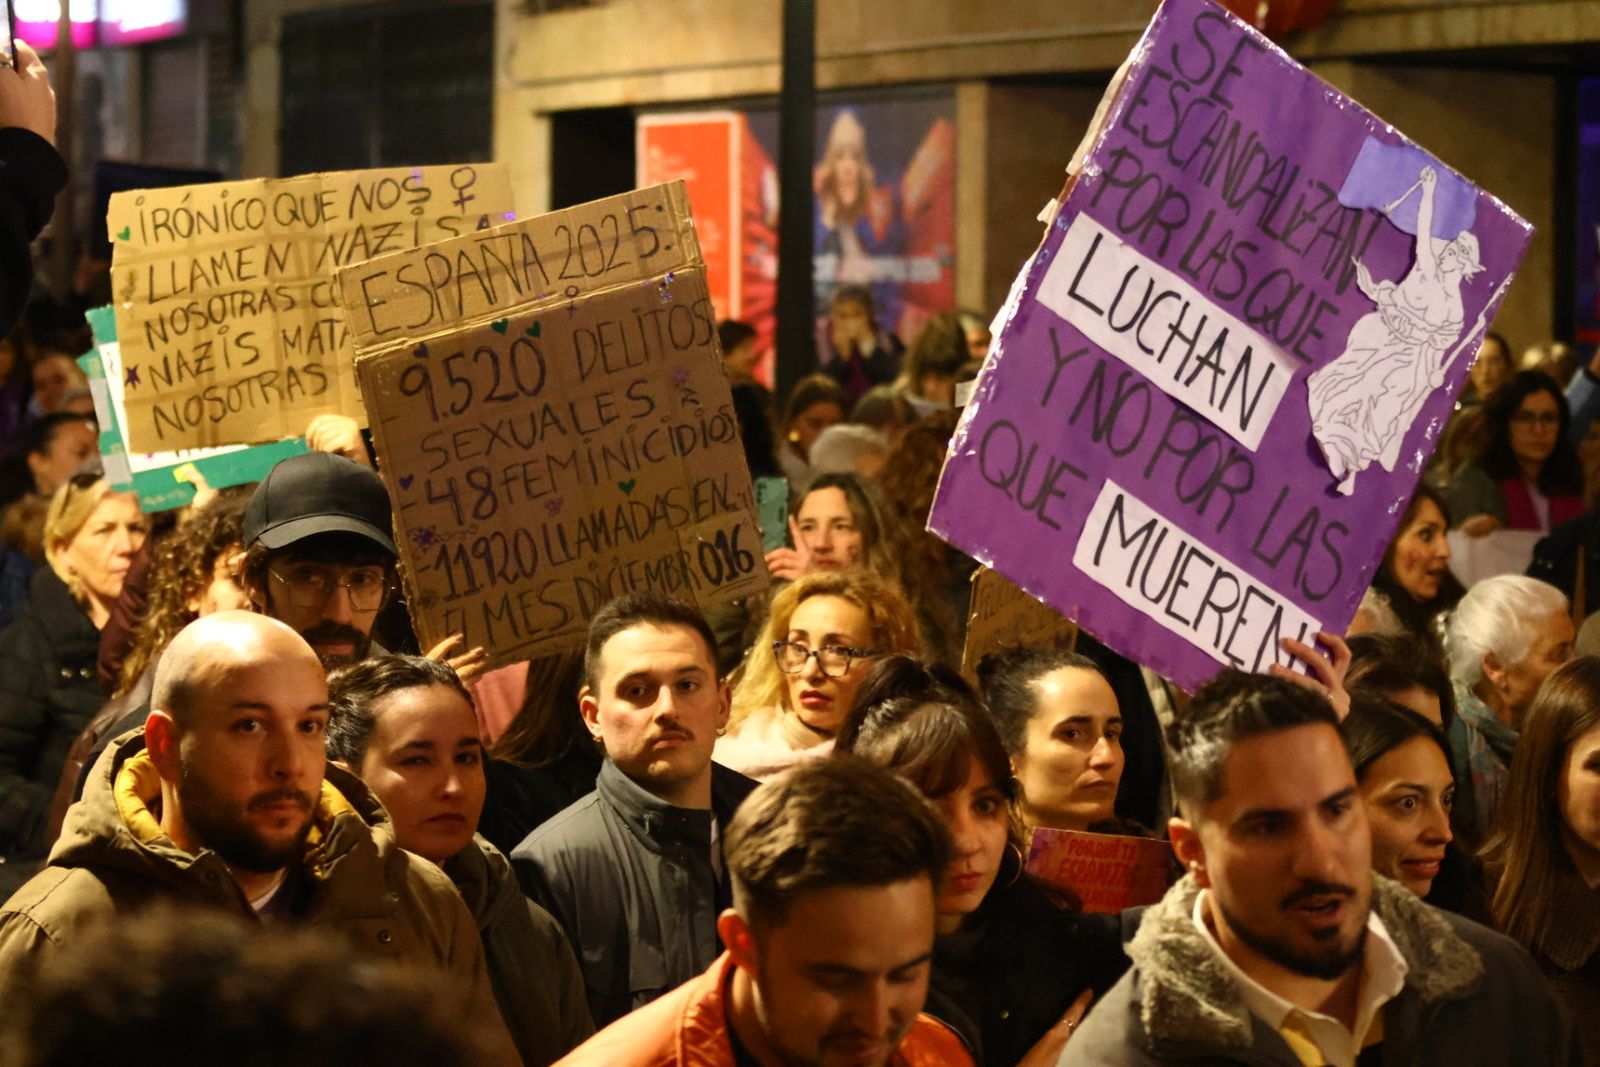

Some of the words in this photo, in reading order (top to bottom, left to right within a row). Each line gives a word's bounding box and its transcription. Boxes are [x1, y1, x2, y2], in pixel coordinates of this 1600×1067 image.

[1172, 11, 1267, 110] SE
[272, 189, 340, 229] QUE
[348, 173, 432, 220] NOS
[1120, 65, 1384, 298] ESCANDALIZAN
[147, 241, 292, 304] LLAMEN
[360, 232, 550, 336] ESPAÑA
[555, 204, 674, 282] 2025:
[1086, 148, 1191, 257] POR
[1177, 221, 1259, 301] LAS
[1246, 268, 1340, 364] QUE
[144, 285, 297, 351] NOSOTRAS
[573, 298, 714, 382] DELITOS
[1066, 231, 1278, 433] LUCHAN
[151, 362, 329, 440] NOSOTRAS
[420, 380, 657, 473] SEXUALES
[977, 420, 1088, 531] QUE
[1038, 327, 1090, 407] Y
[1068, 356, 1151, 457] NO
[1142, 406, 1256, 531] POR
[1250, 483, 1351, 601] LAS
[541, 486, 690, 567] LLAMADAS
[697, 523, 755, 586] 016
[482, 578, 572, 647] MES
[1092, 493, 1309, 676] MUEREN
